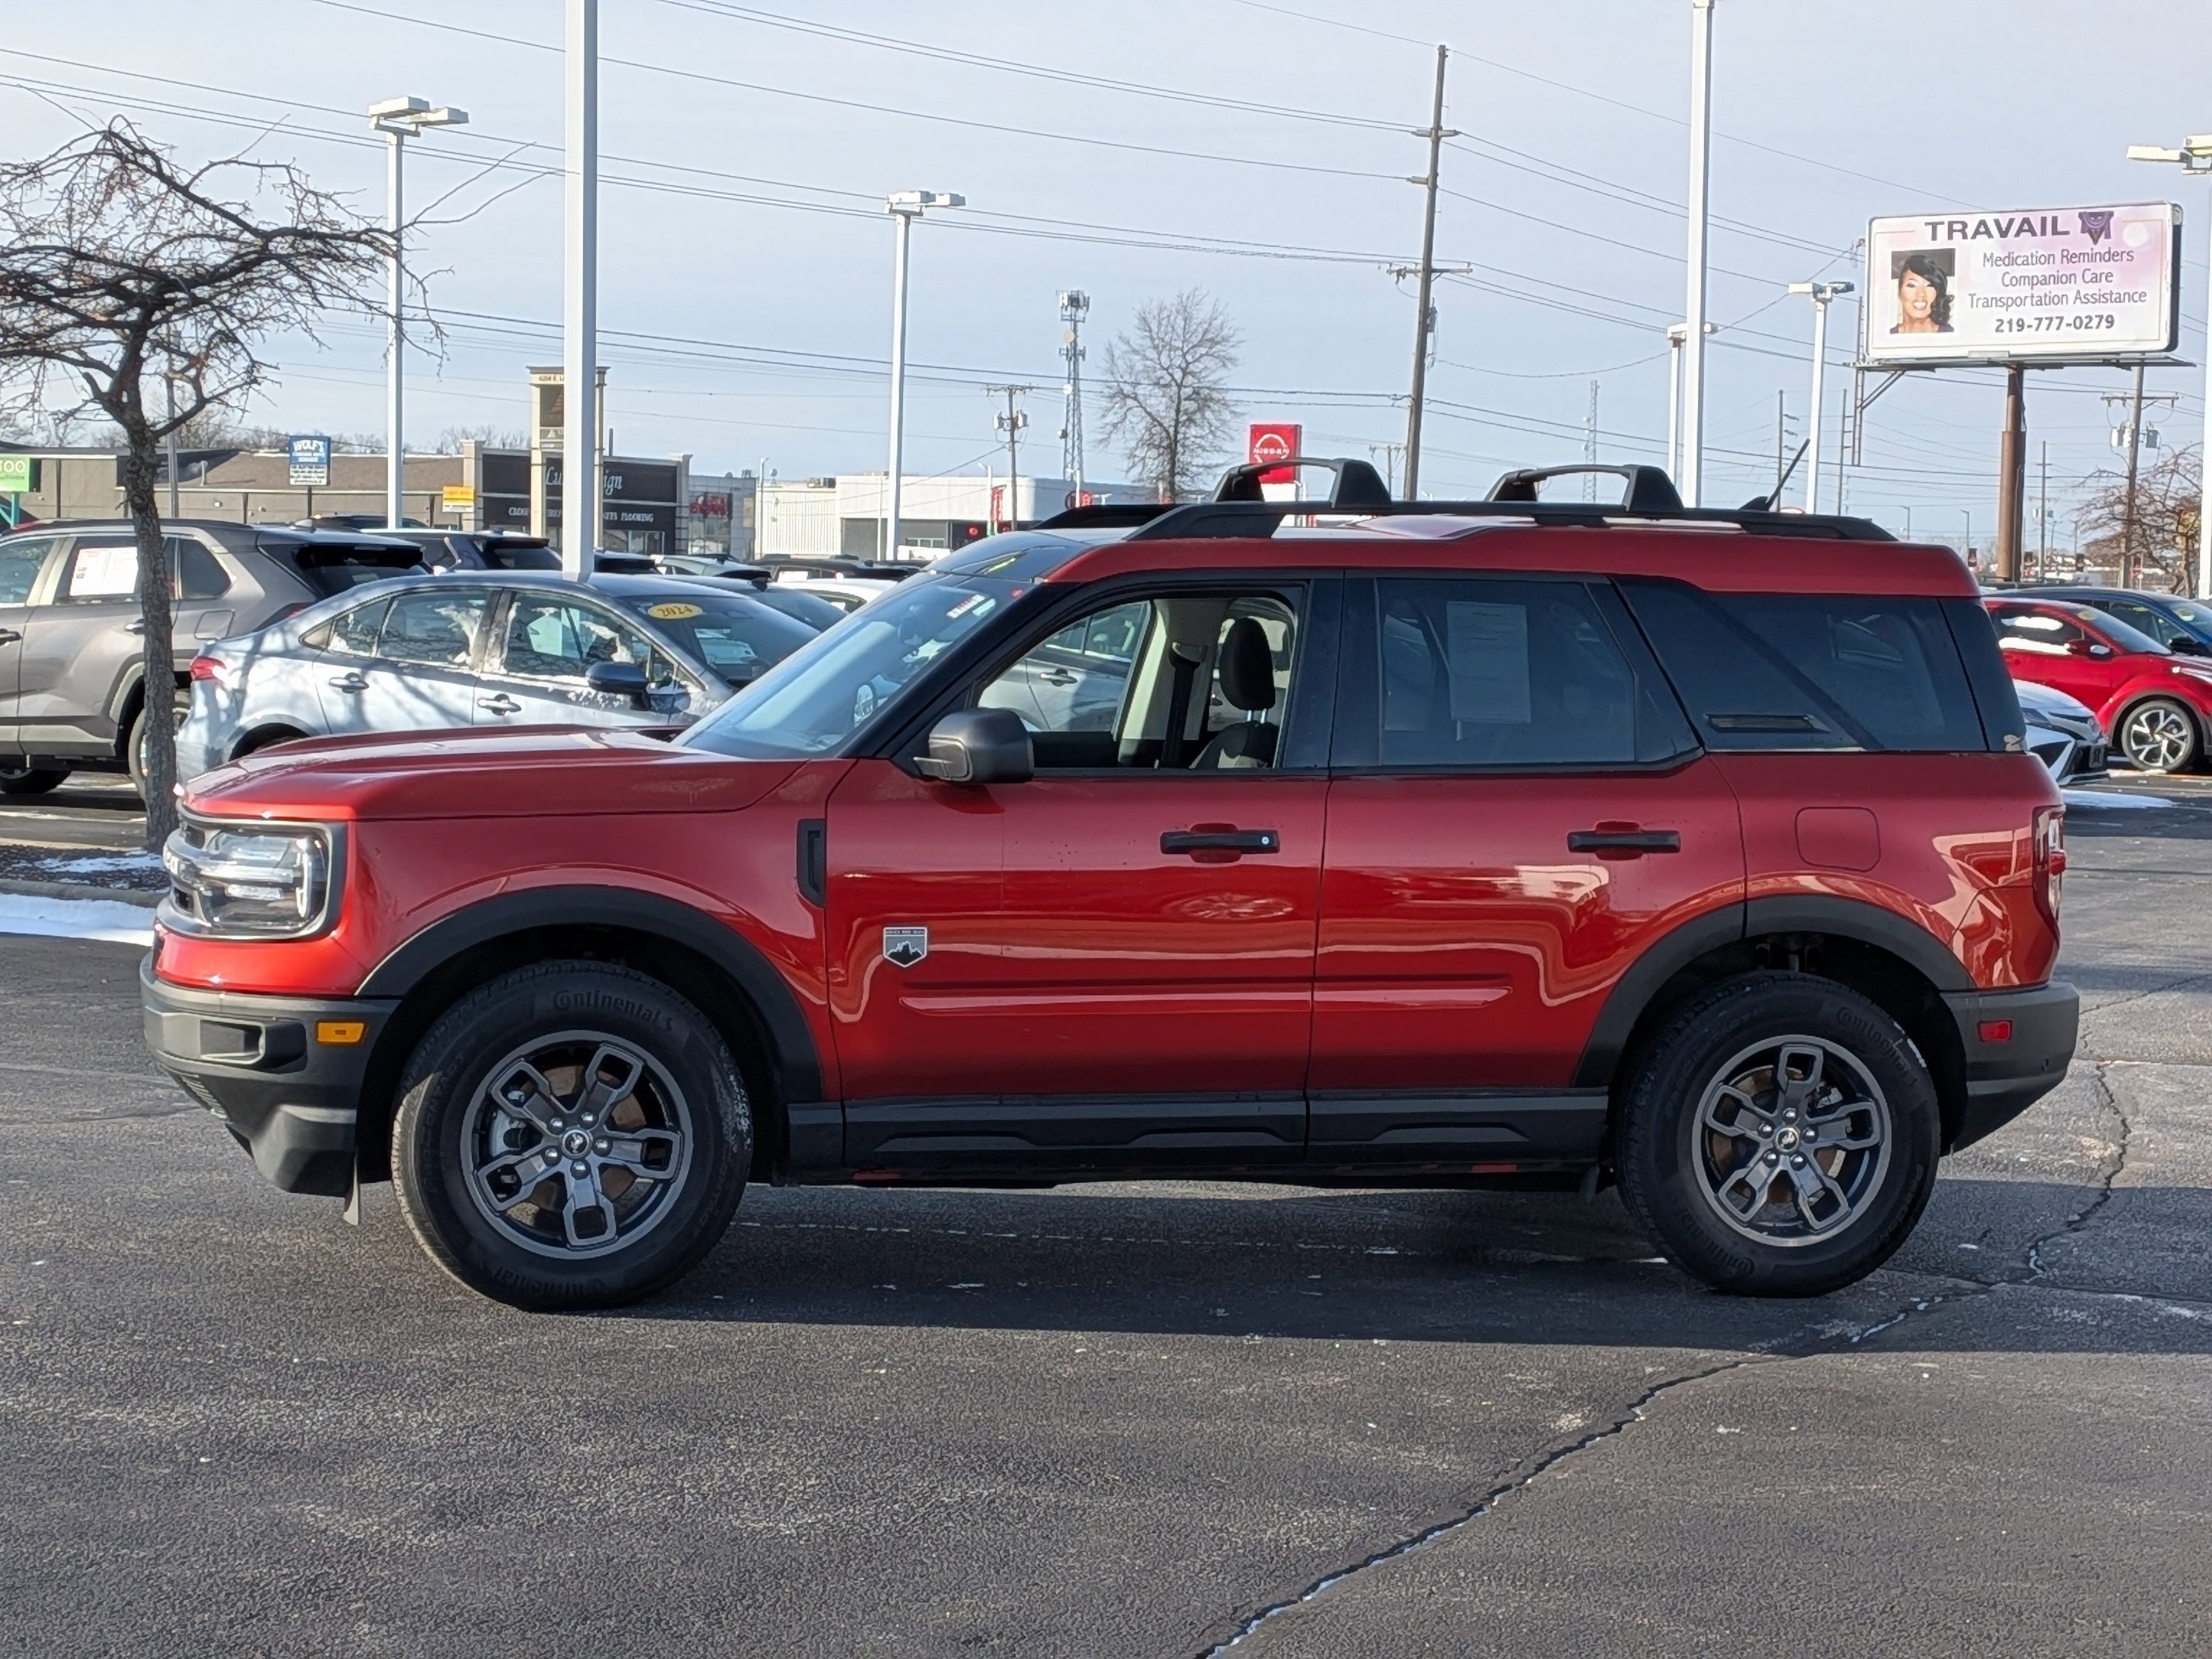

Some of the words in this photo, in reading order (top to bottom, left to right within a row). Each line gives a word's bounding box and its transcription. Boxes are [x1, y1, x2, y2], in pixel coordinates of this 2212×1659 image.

[1924, 216, 2070, 241] TRAVAIL
[1983, 251, 2056, 267] Medication
[2060, 247, 2135, 264] Reminders
[2001, 270, 2077, 290] Companion
[2081, 268, 2114, 284] Care
[1968, 291, 2068, 311] Transportation
[2073, 289, 2147, 305] Assistance
[1995, 314, 2115, 332] 219-777-0279
